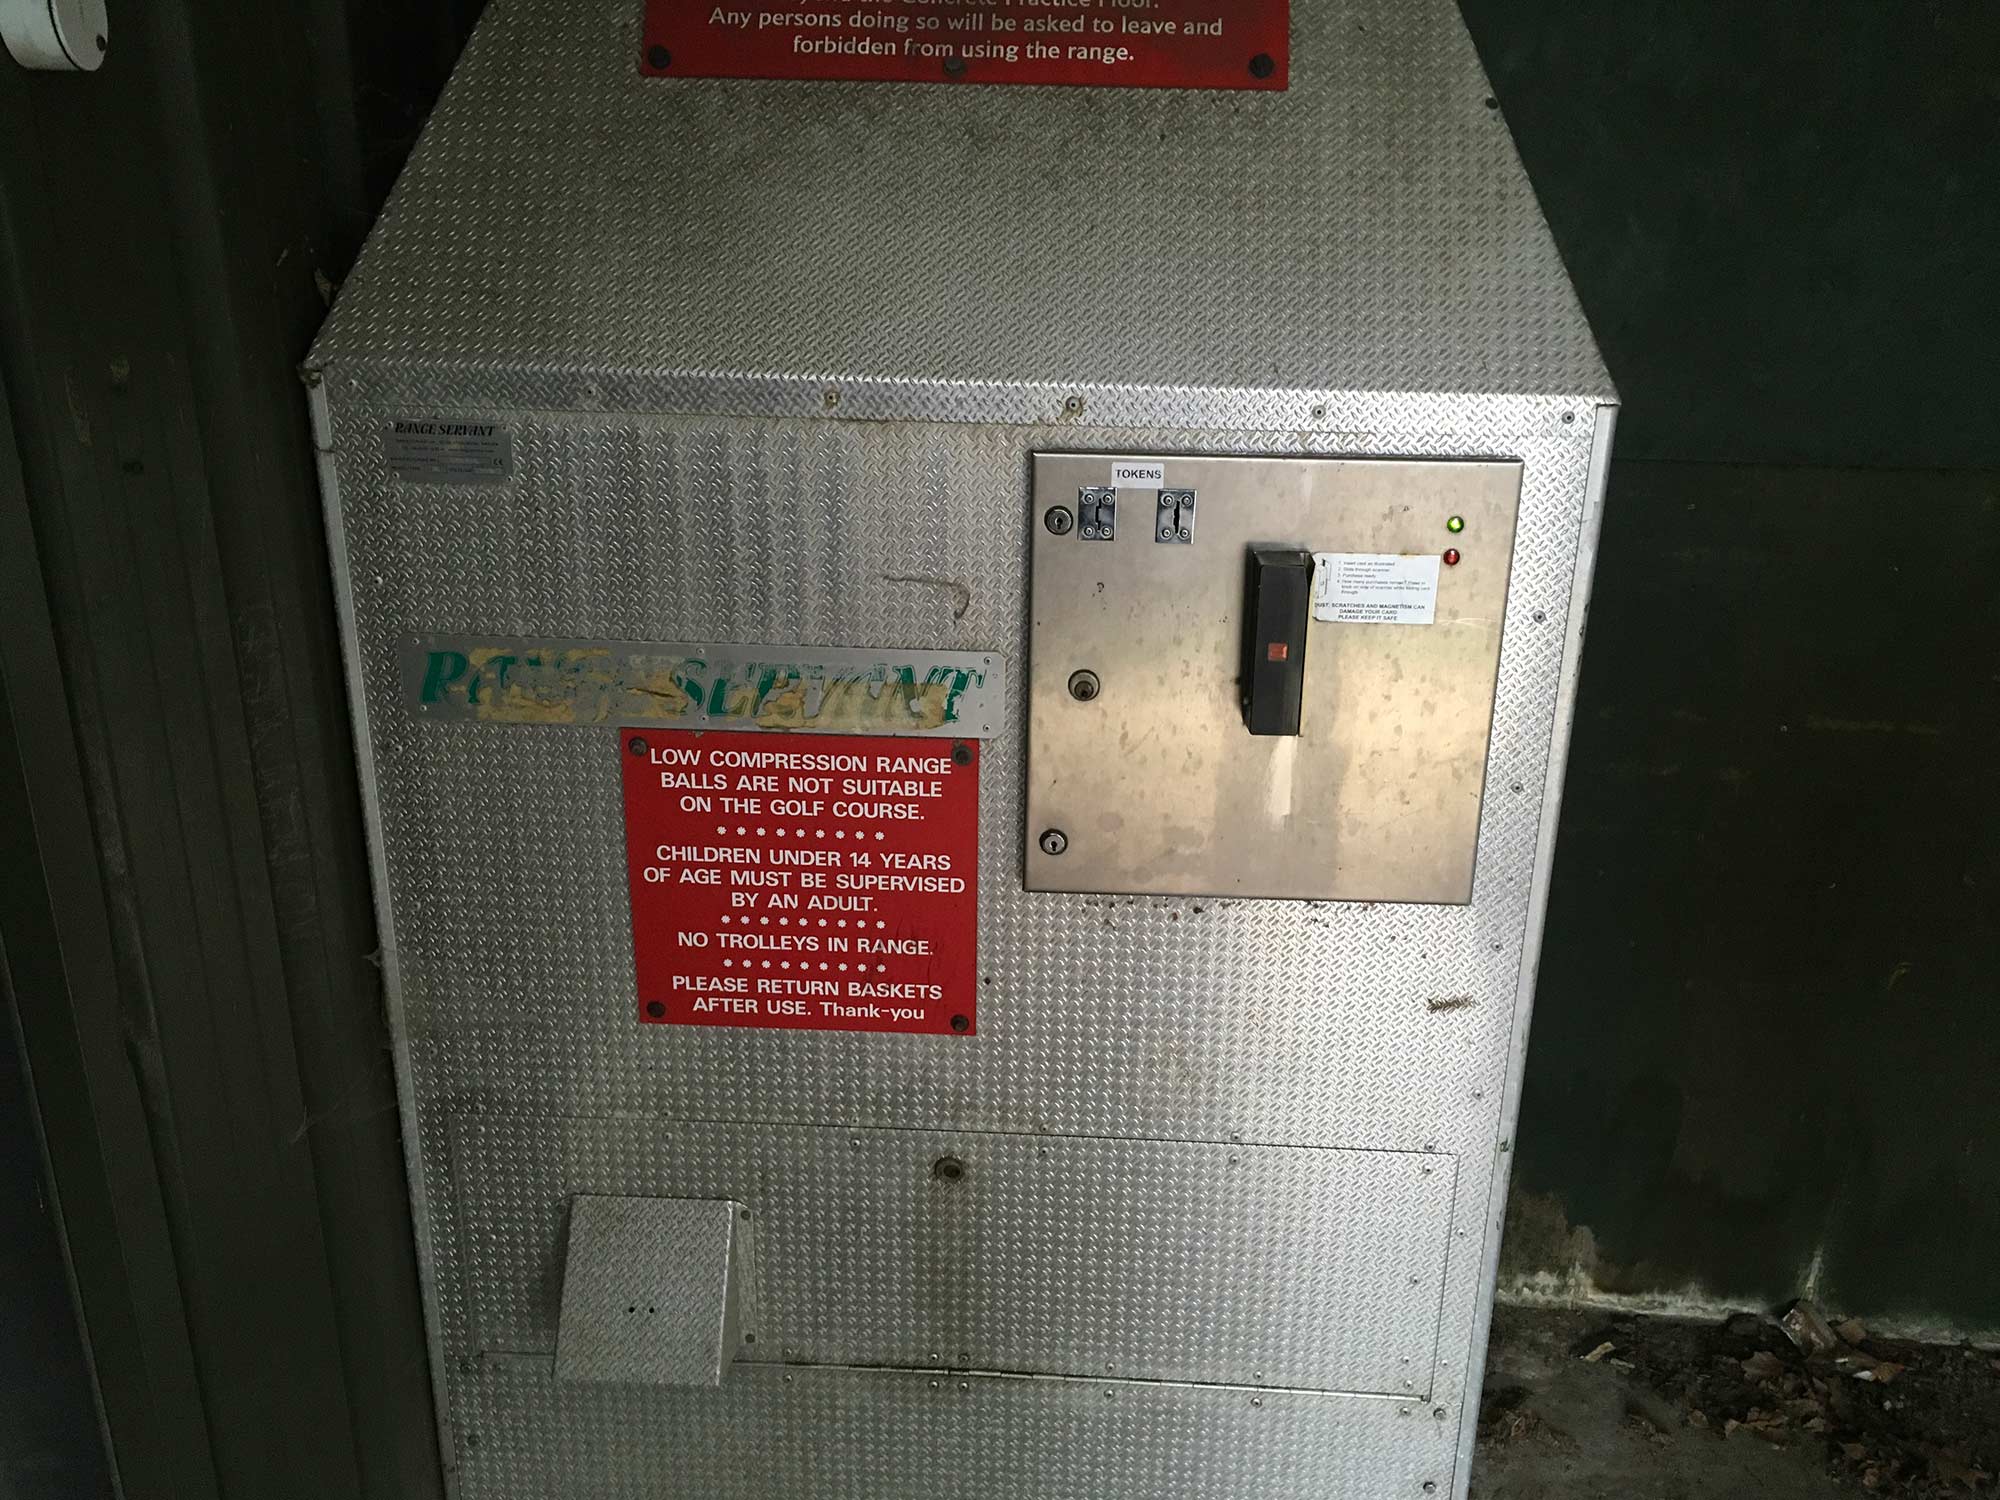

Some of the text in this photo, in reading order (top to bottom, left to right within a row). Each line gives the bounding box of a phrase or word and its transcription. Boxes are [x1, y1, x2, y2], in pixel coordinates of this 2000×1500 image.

[709, 8, 1222, 35] Any persons doing so will be asked to leave and
[794, 35, 1134, 64] forbidden from using the range.
[395, 422, 496, 436] RANGE SERVANT
[1115, 469, 1162, 479] TOKENS
[651, 749, 951, 774] LOW COMPRESSION RANGE
[661, 773, 942, 797] BALLS ARE NOT SUITABLE
[681, 796, 924, 819] ON THE GOLF COURSE.
[657, 846, 950, 870] CHILDREN UNDER 14 YEARS
[644, 867, 964, 892] OF AGE MUST BE SUPERVISED
[732, 893, 877, 911] BY AN ADULT.
[679, 932, 932, 955] NO TROLLEYS IN RANGE.
[673, 976, 942, 999] PLEASE RETURN BASKETS
[693, 998, 924, 1021] AFTER USE. Thank-you
